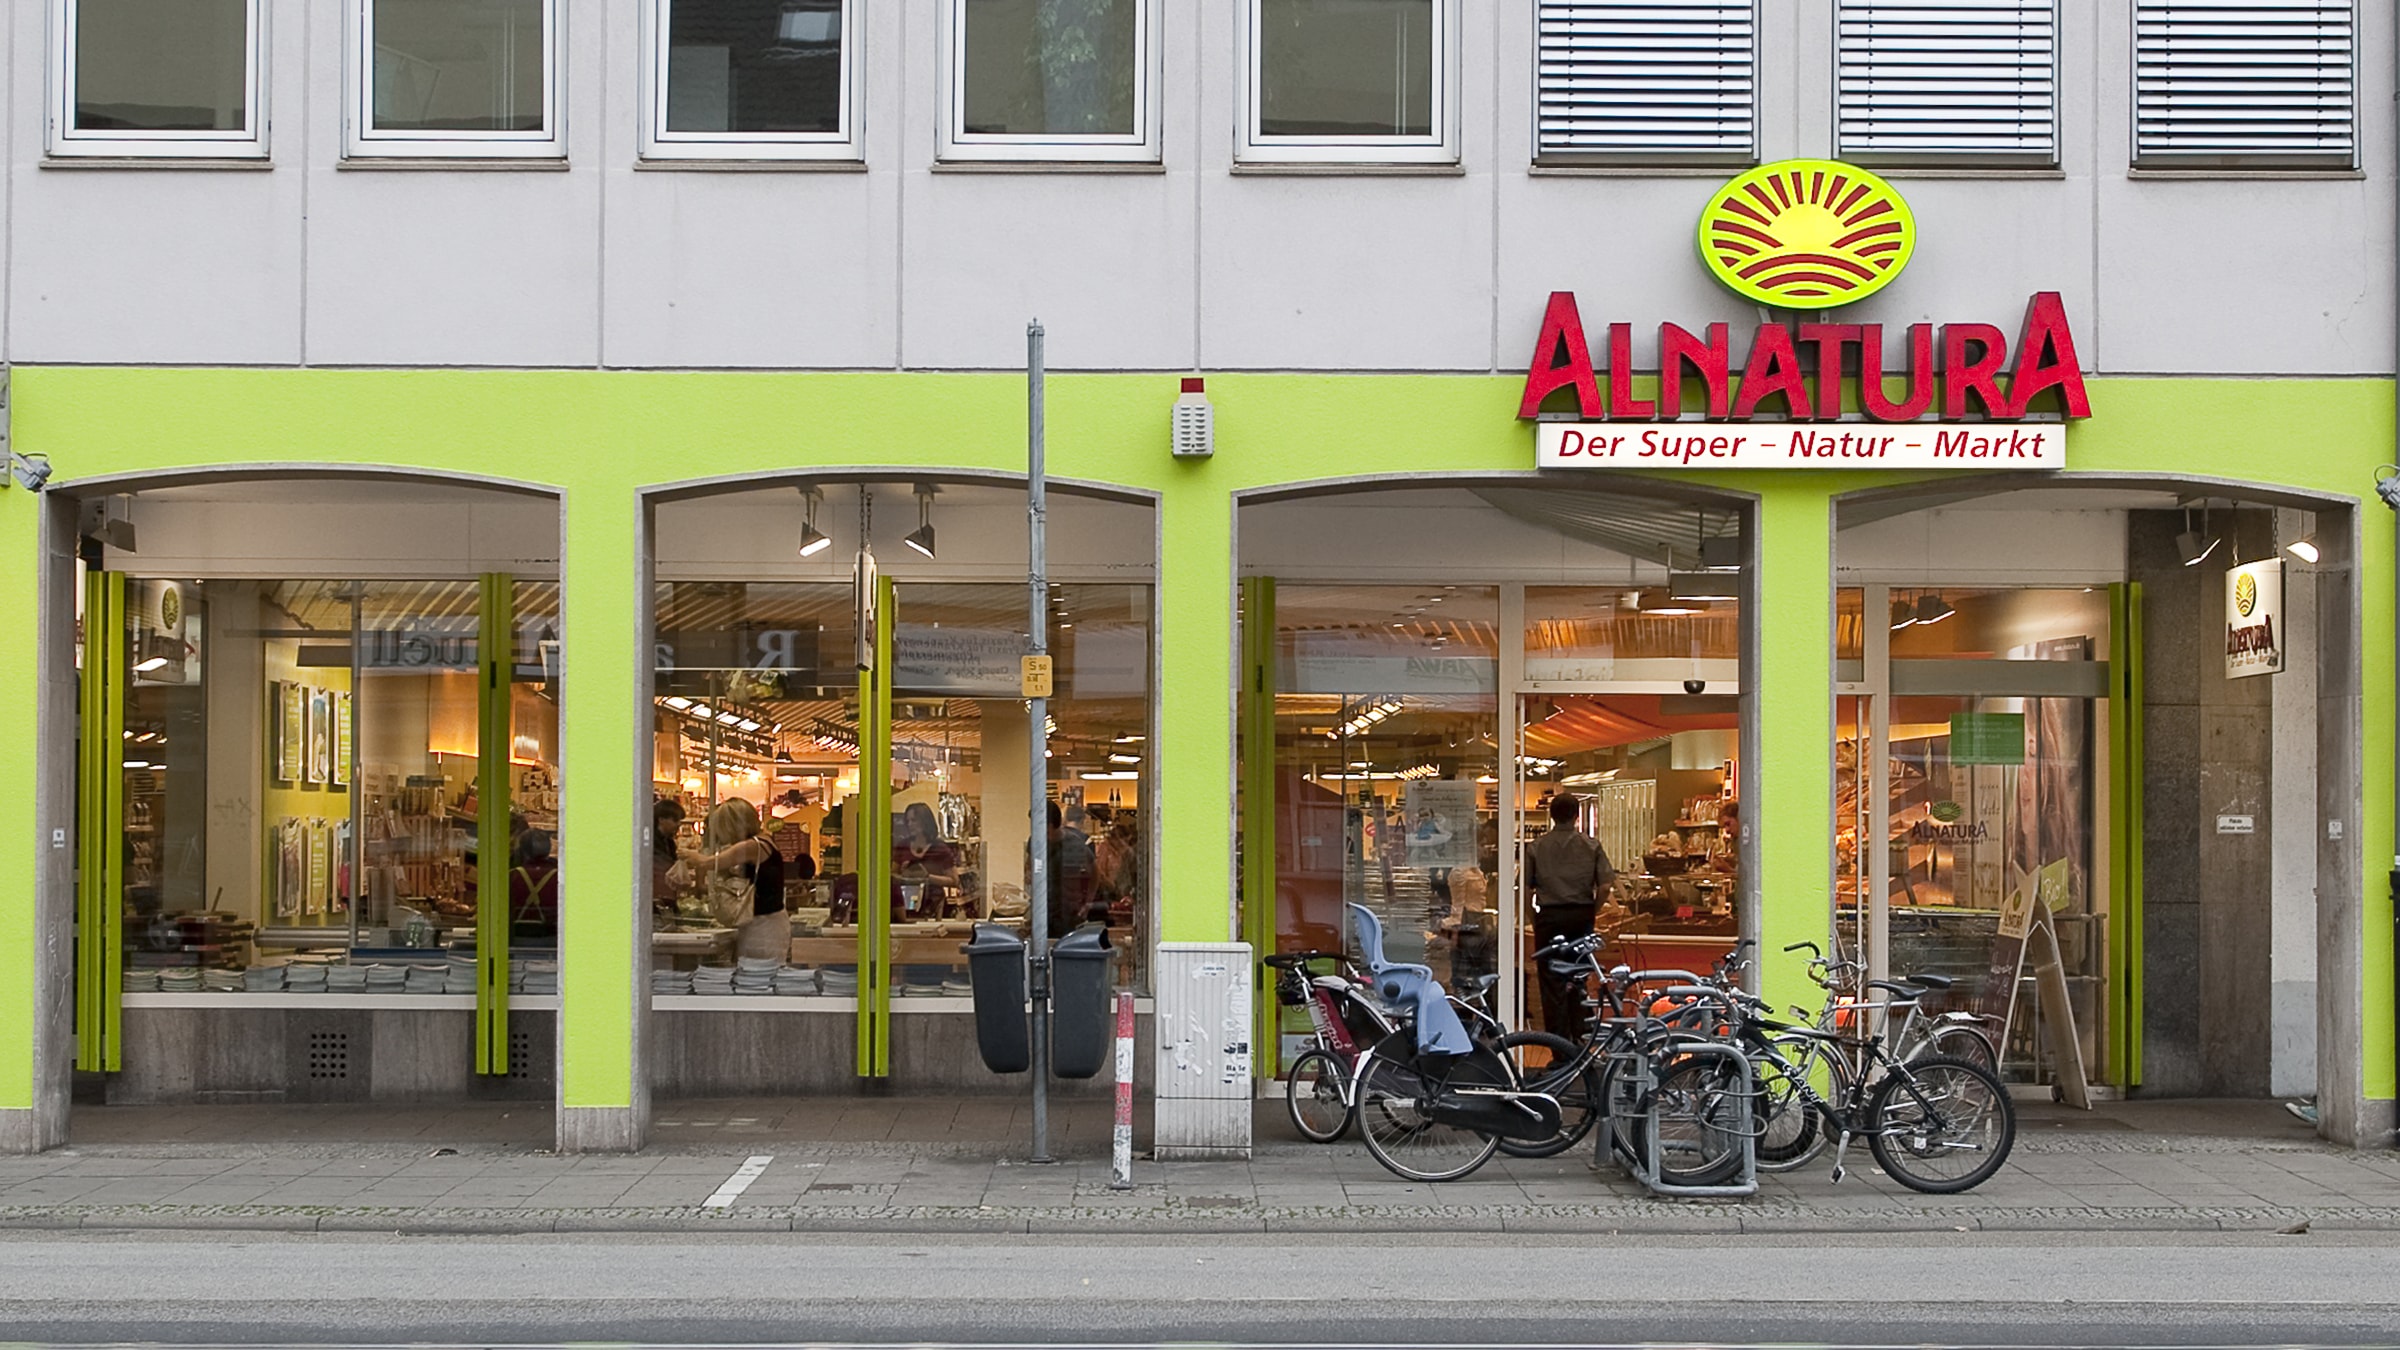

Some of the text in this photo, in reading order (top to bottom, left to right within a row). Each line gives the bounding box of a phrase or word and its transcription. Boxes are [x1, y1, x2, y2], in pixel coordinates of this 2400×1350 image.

[1517, 291, 2092, 421] ALNATURA
[1558, 429, 1626, 458] Der
[1637, 429, 1747, 465] Super
[1788, 430, 1895, 459] Natur
[1932, 428, 2046, 459] Markt
